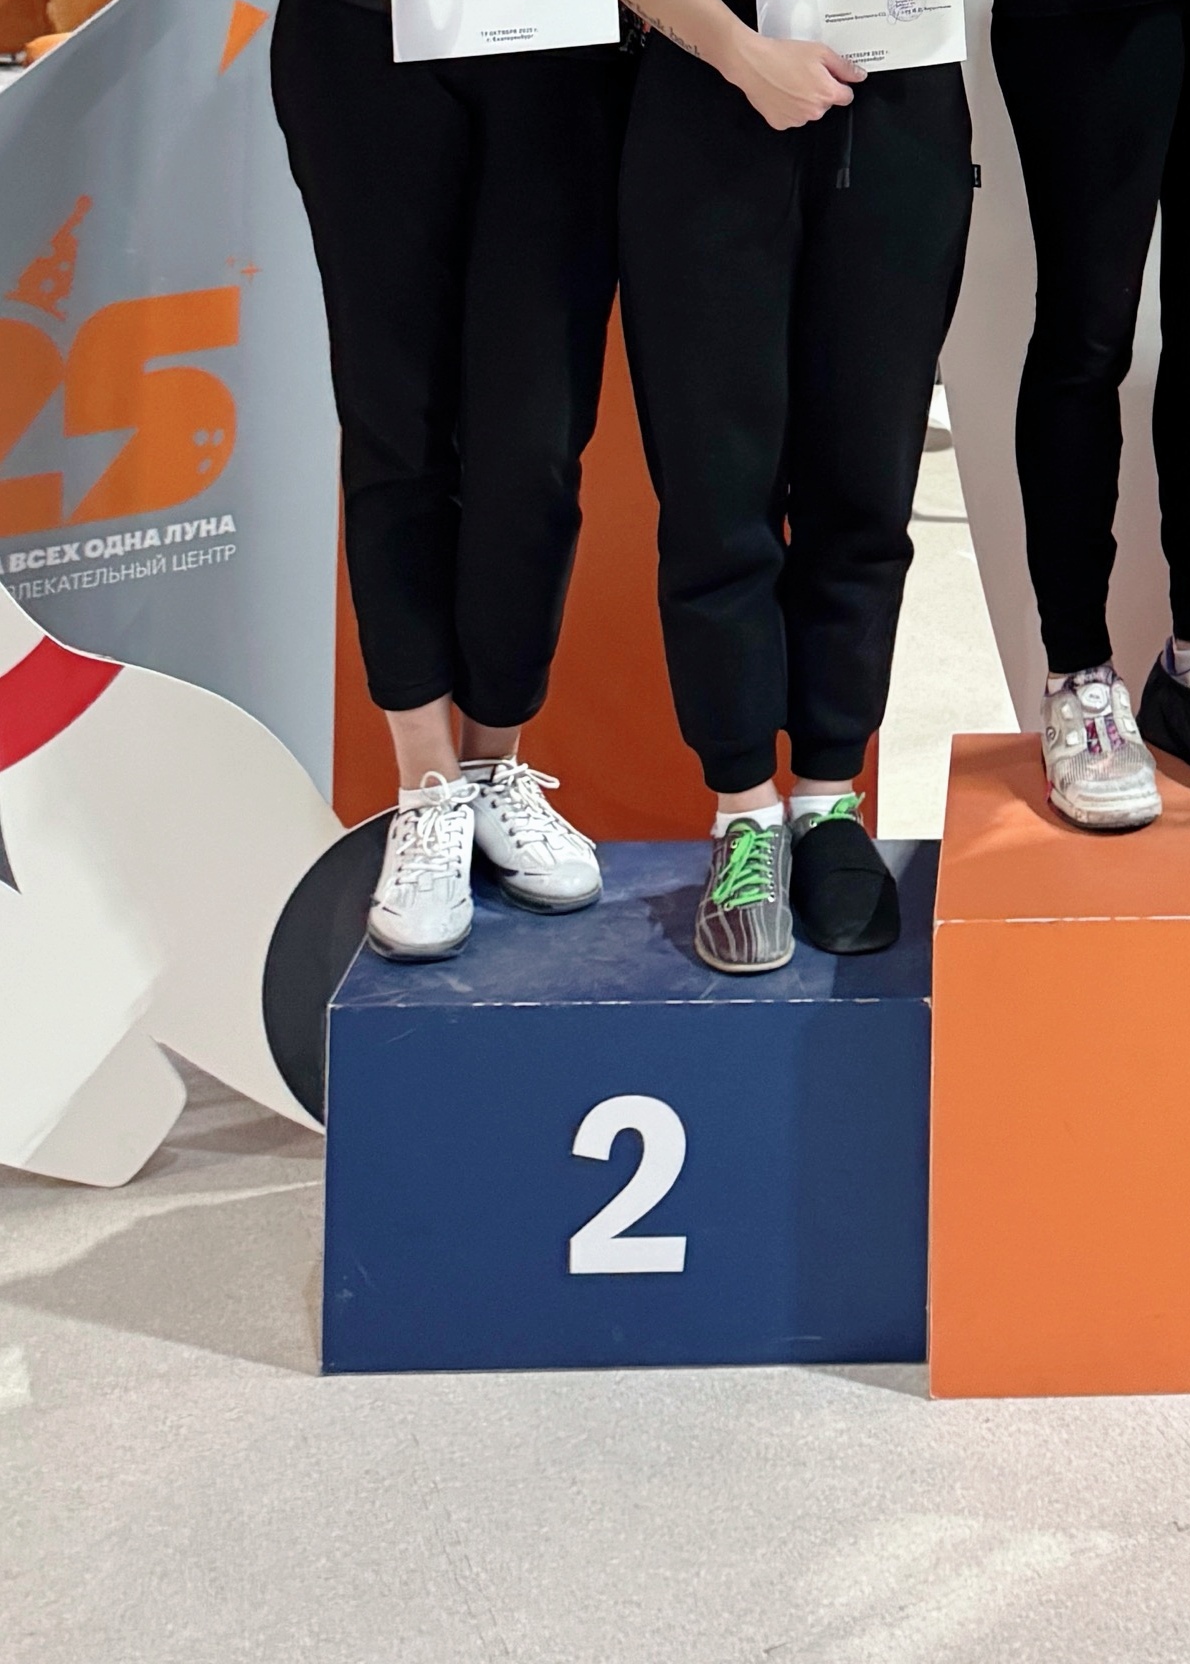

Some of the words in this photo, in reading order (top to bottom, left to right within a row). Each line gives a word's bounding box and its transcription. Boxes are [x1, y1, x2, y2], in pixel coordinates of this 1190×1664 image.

[8, 542, 81, 573] ВСЕХ
[84, 528, 161, 558] ОДНА
[164, 514, 236, 545] ЛУНА
[172, 544, 236, 571] ЦЕНТР
[569, 1094, 687, 1274] 2
